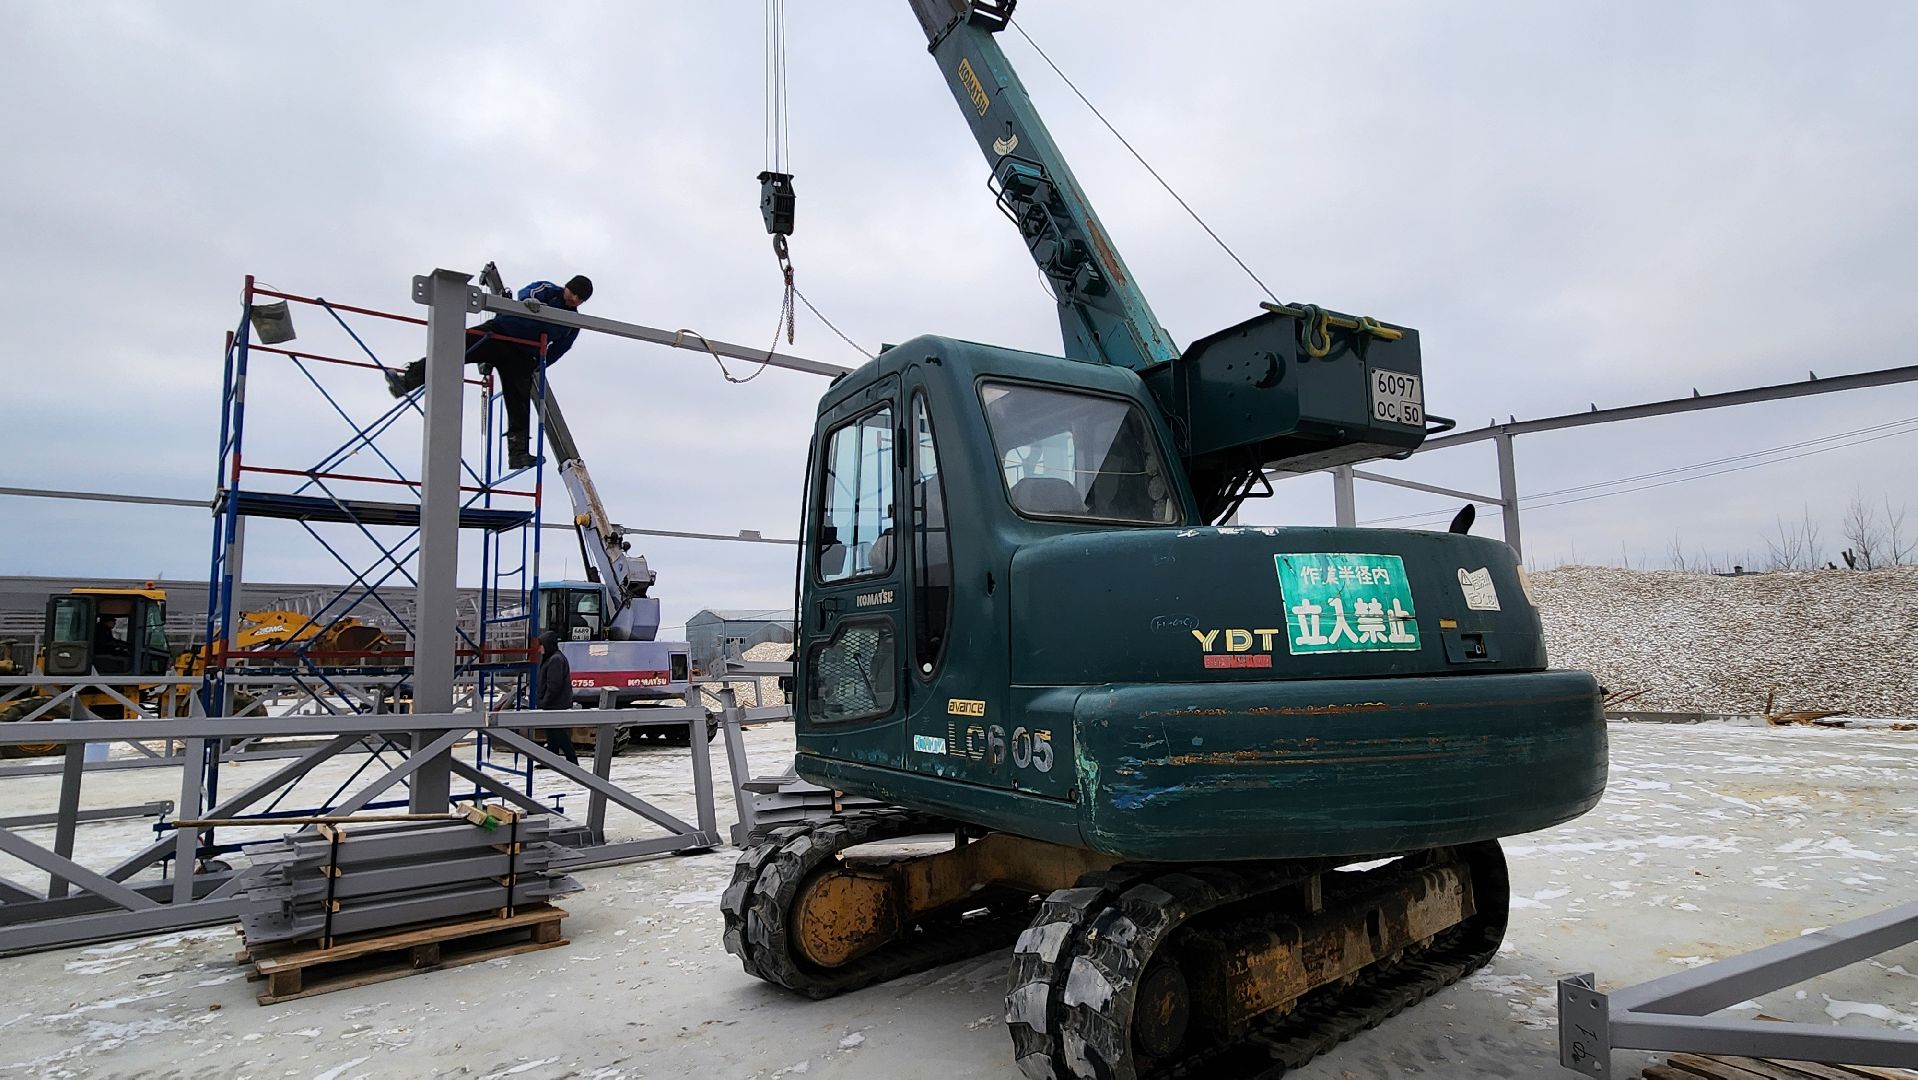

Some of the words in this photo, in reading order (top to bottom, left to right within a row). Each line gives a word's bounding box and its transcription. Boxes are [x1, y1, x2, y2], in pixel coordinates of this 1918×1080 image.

[959, 62, 987, 114] KOMATSU
[1378, 373, 1415, 398] 6097
[1404, 405, 1419, 422] 50
[856, 588, 894, 607] KOMATSU
[1291, 597, 1416, 646] 立入禁止
[1191, 629, 1279, 652] YDT
[627, 676, 667, 686] KOMATSU
[949, 701, 984, 714] avance
[948, 720, 1054, 773] LC605
